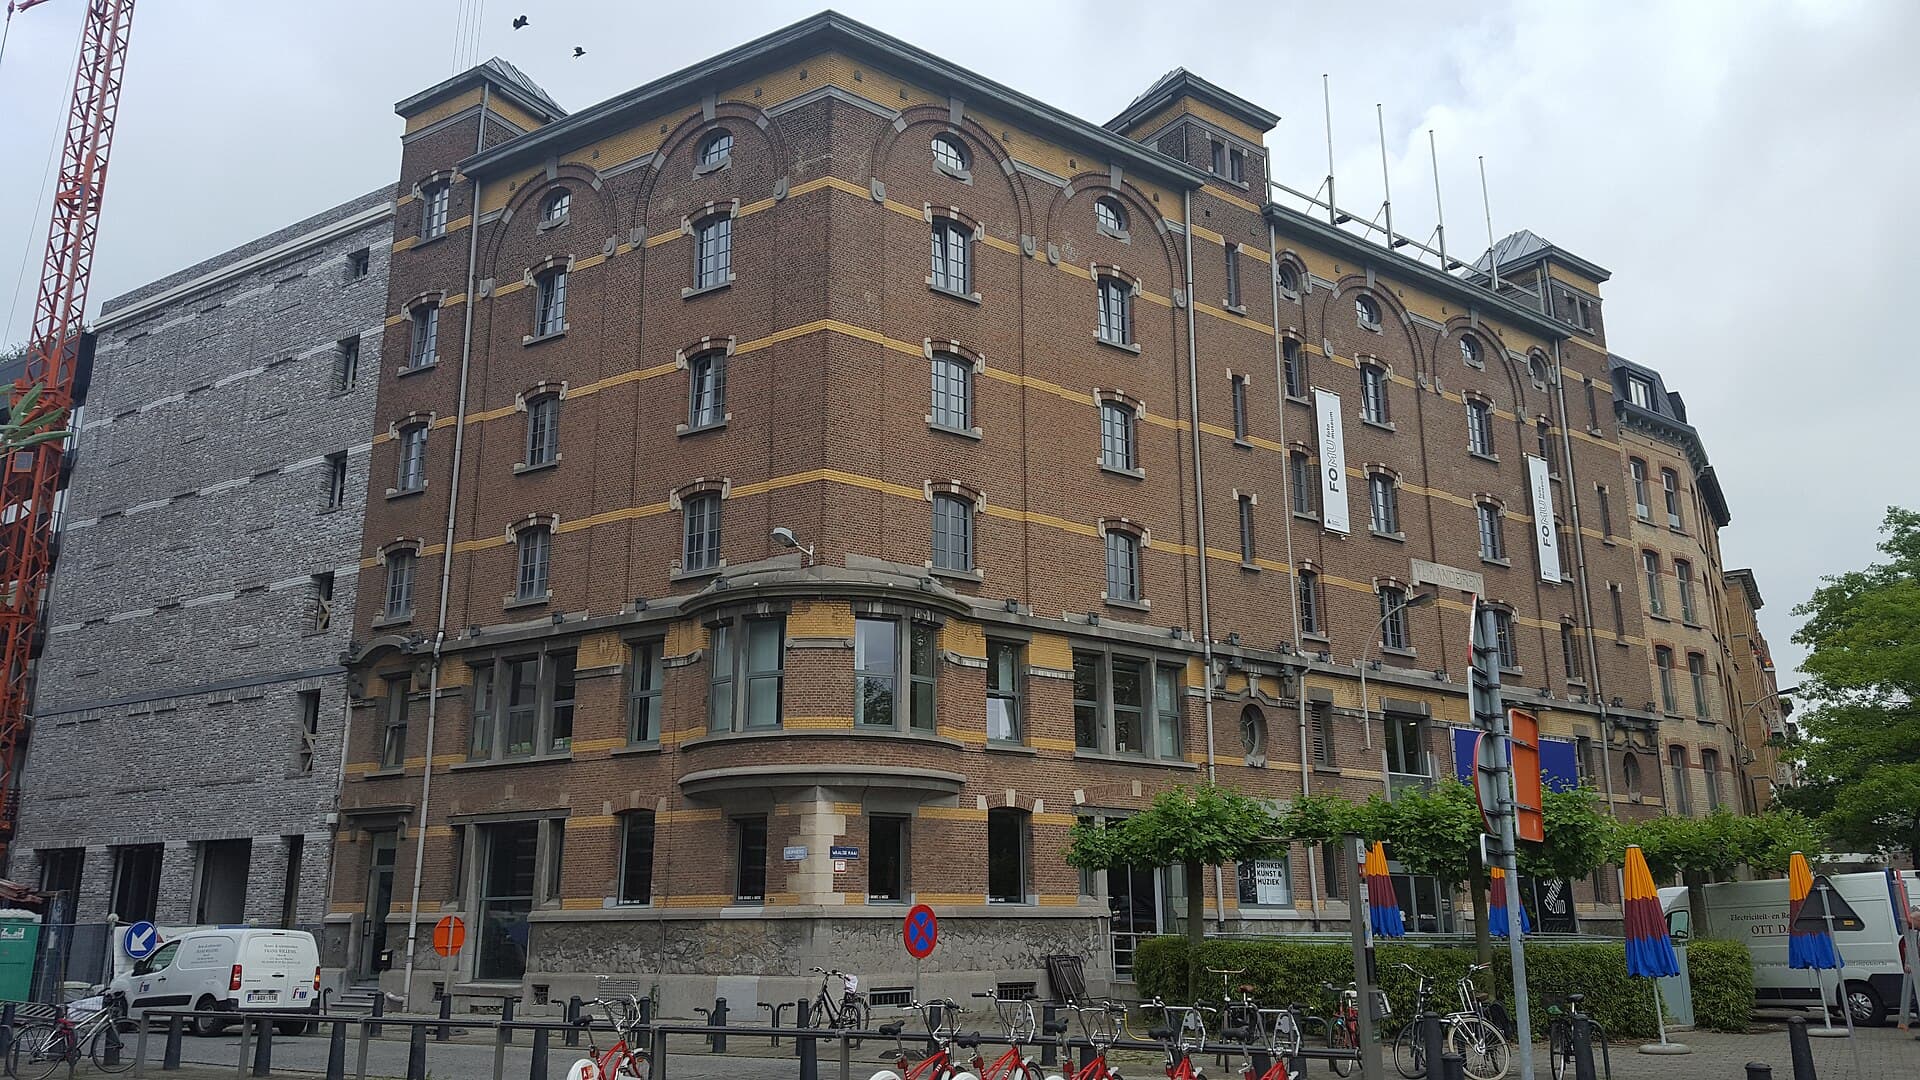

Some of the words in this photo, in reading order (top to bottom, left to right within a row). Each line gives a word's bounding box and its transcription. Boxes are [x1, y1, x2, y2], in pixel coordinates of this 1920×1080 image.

[1326, 440, 1340, 492] FOMU
[1538, 500, 1552, 548] FOMU
[1413, 561, 1481, 591] VLAANDEREN
[1256, 861, 1282, 869] DRINKEN
[1751, 924, 1773, 935] OTT
